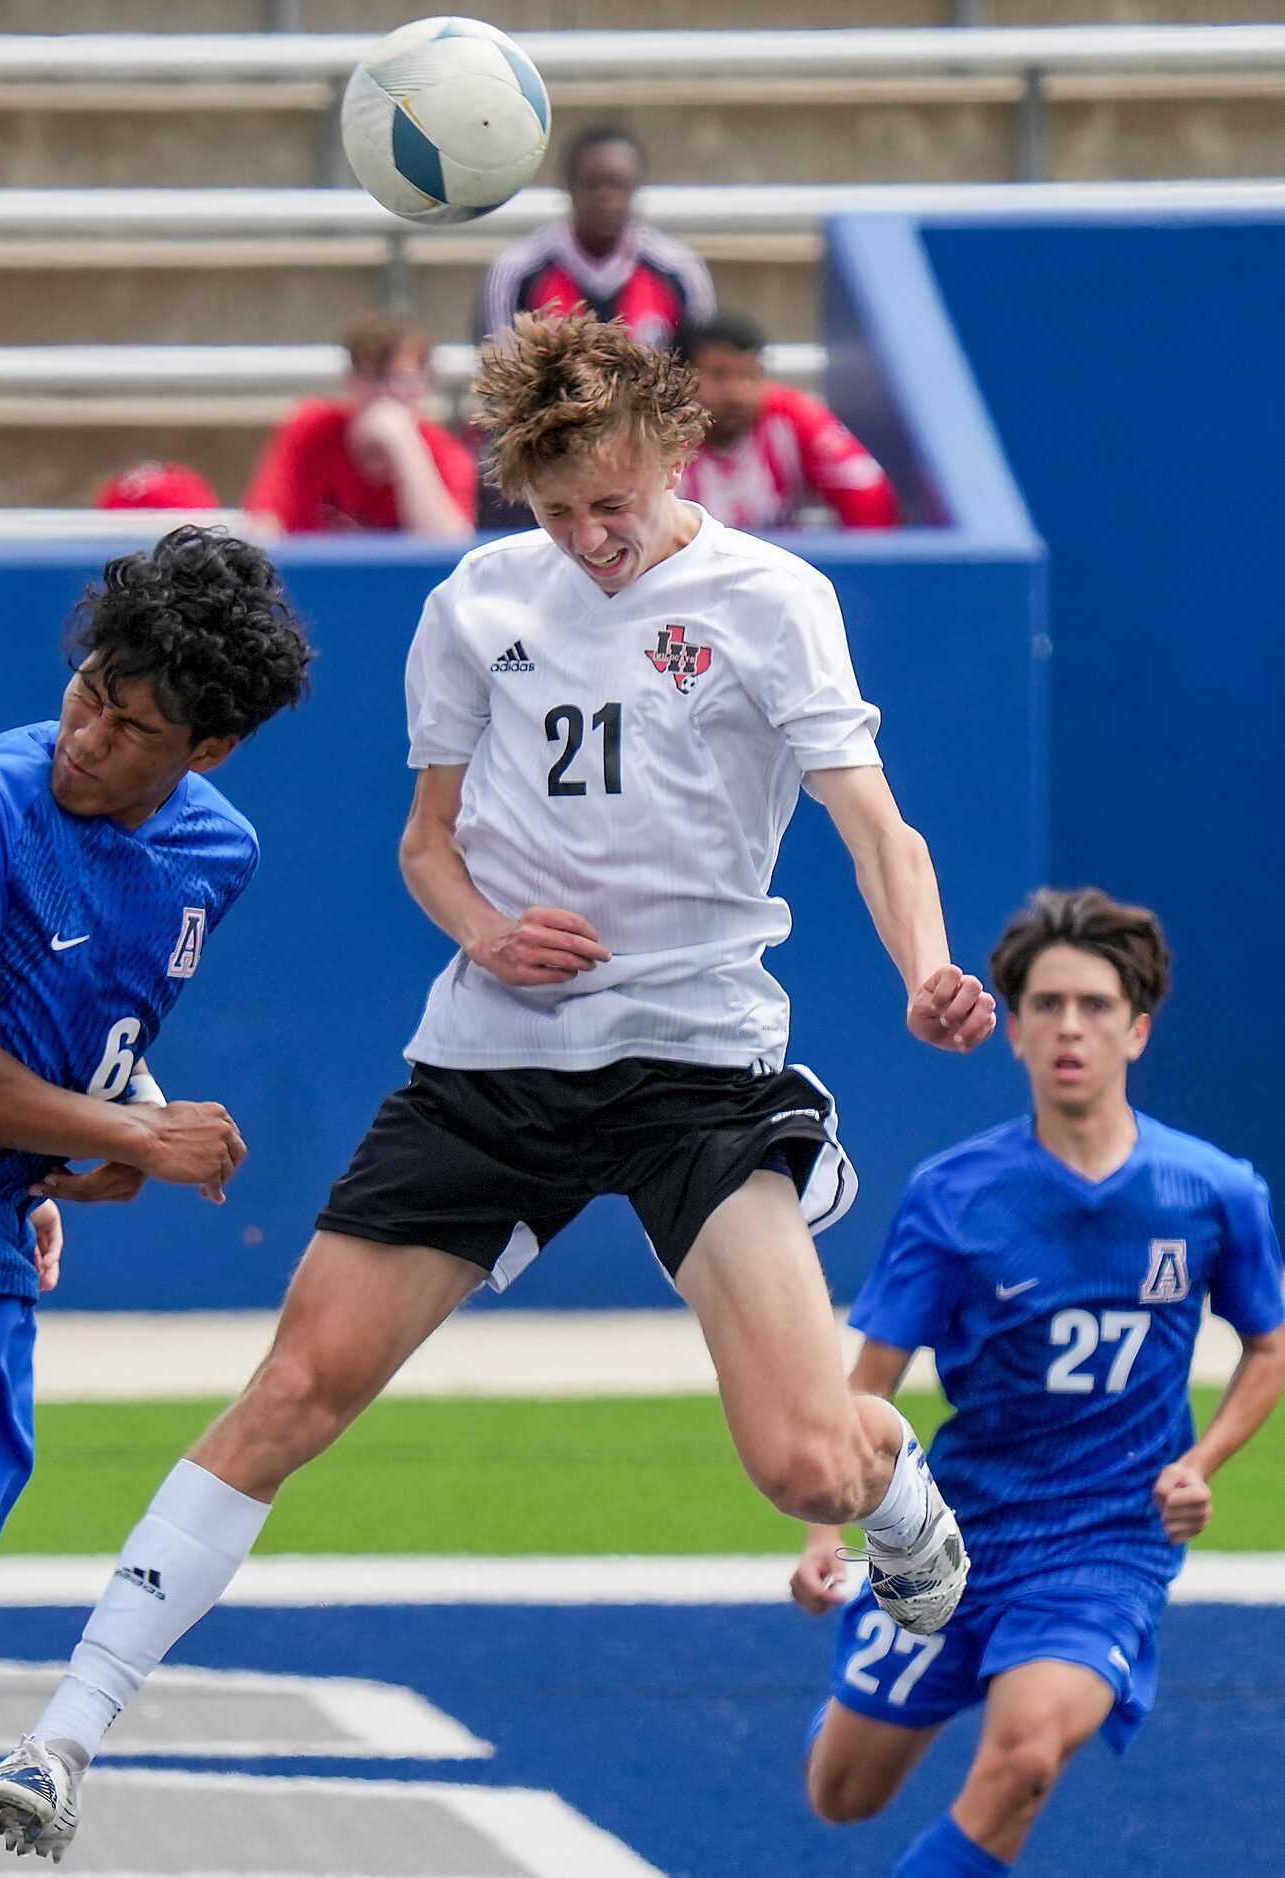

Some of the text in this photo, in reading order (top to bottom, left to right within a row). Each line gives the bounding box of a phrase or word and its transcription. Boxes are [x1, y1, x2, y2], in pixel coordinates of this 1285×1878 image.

[490, 659, 535, 672] adidas
[544, 702, 622, 797] 21
[167, 907, 206, 979] A
[87, 1016, 141, 1101] 6
[1139, 1238, 1190, 1304] A
[1046, 1308, 1152, 1394] 27
[844, 1609, 947, 1707] 27
